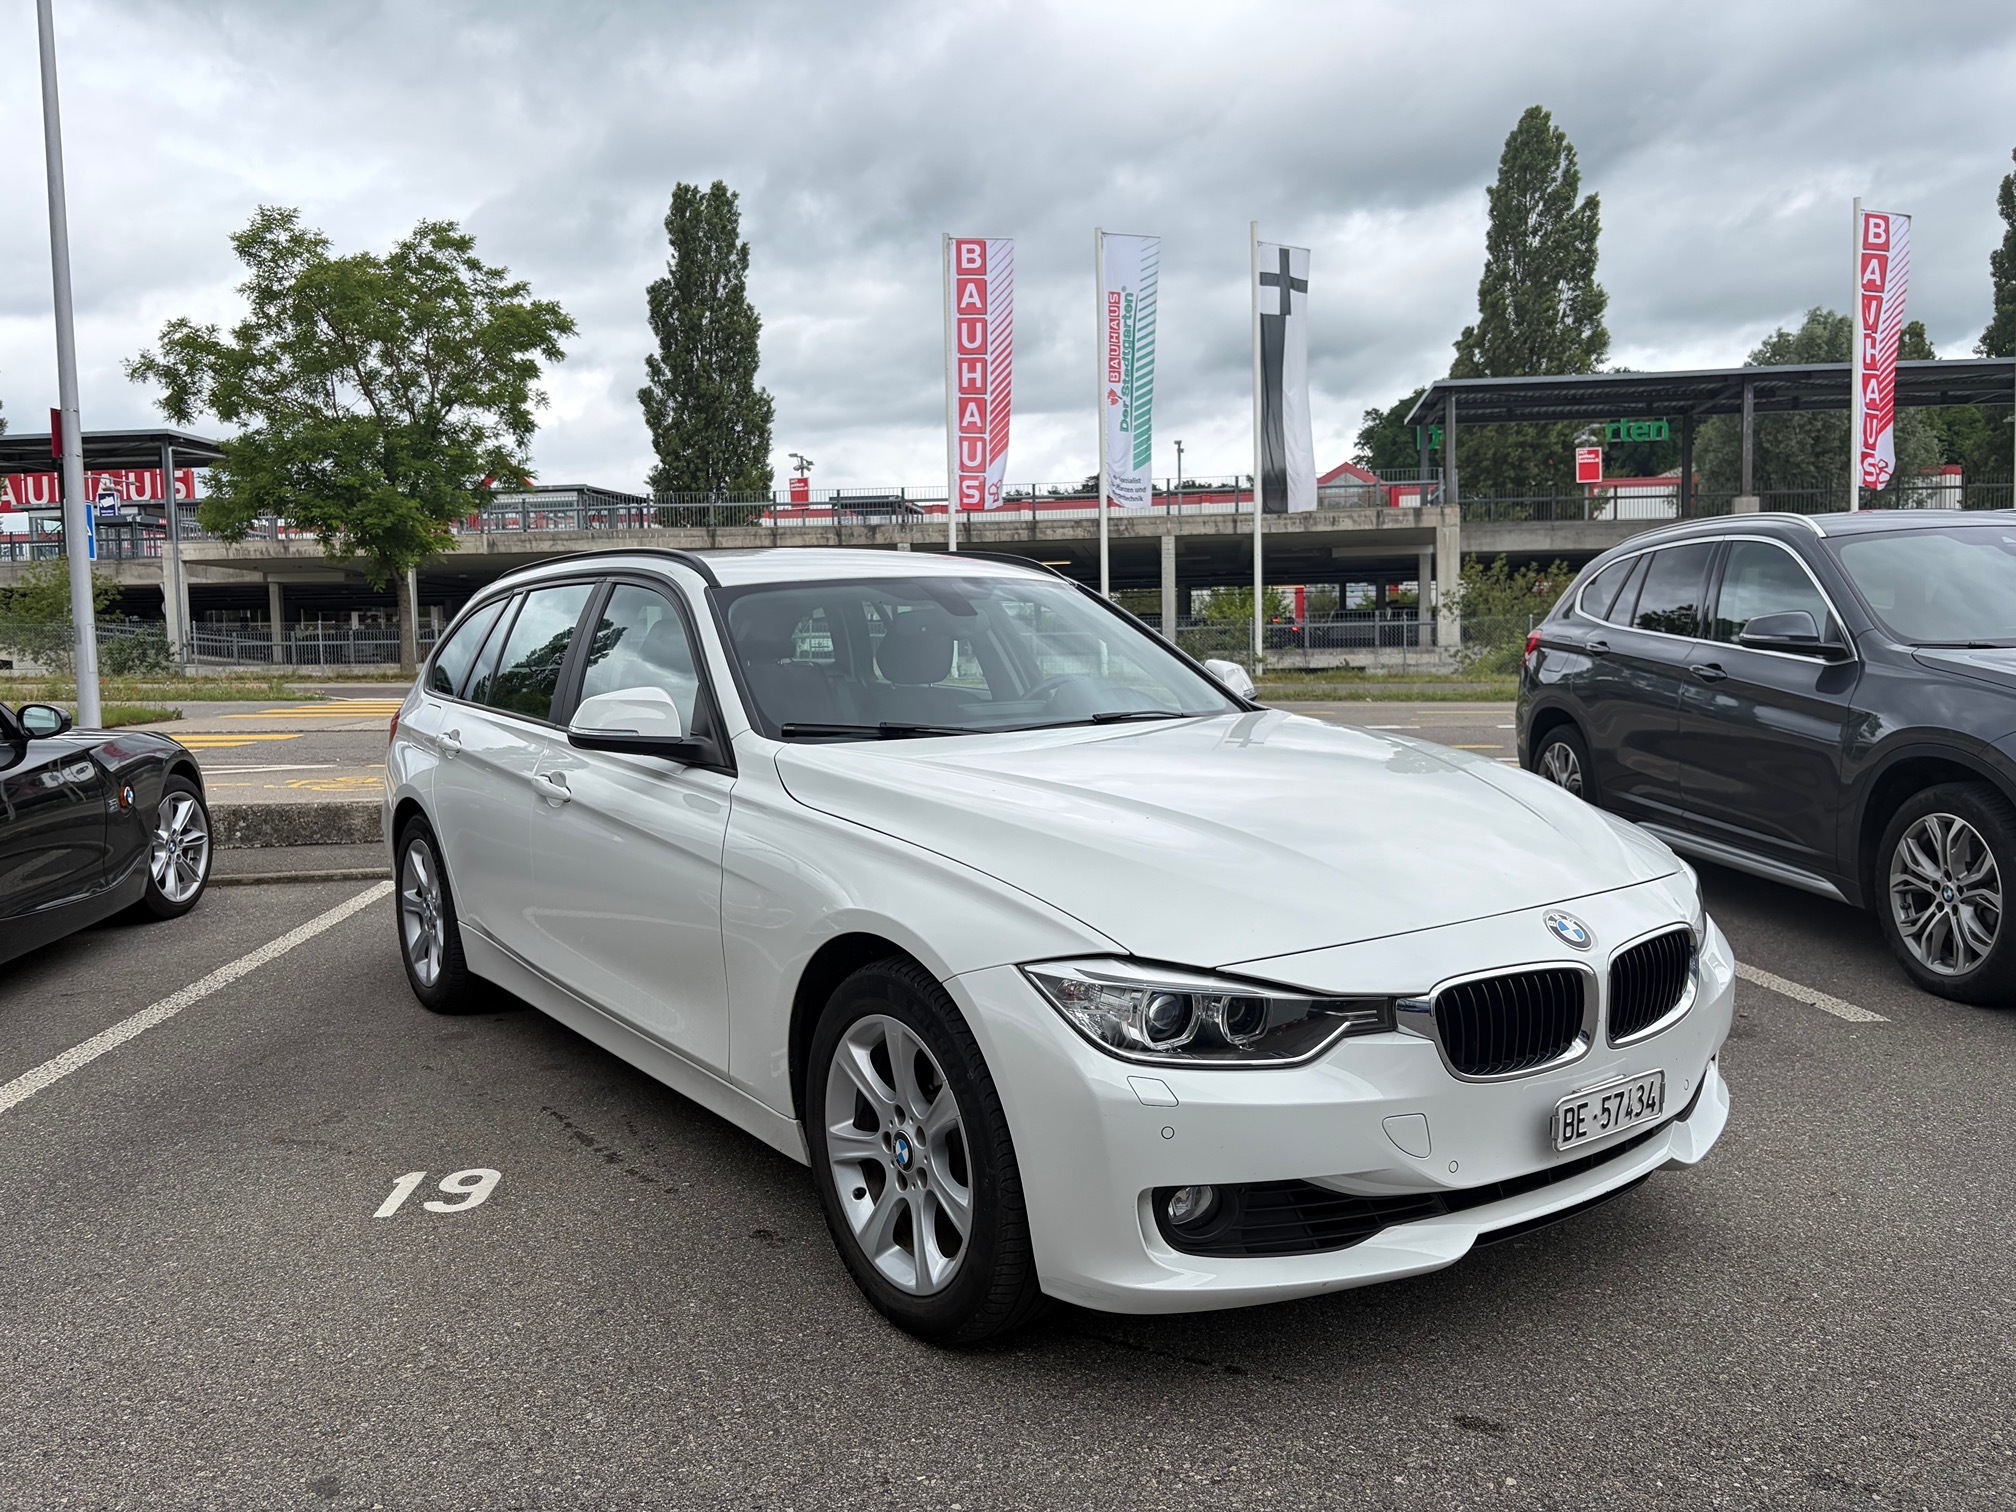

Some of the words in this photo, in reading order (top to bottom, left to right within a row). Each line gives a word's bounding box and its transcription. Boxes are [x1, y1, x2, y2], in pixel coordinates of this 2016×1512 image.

[960, 243, 984, 505] BAUHAUS
[1109, 292, 1120, 382] BAUHAUS
[1121, 292, 1134, 398] Stadtgarten
[1120, 400, 1130, 432] Der
[373, 1168, 502, 1218] 19
